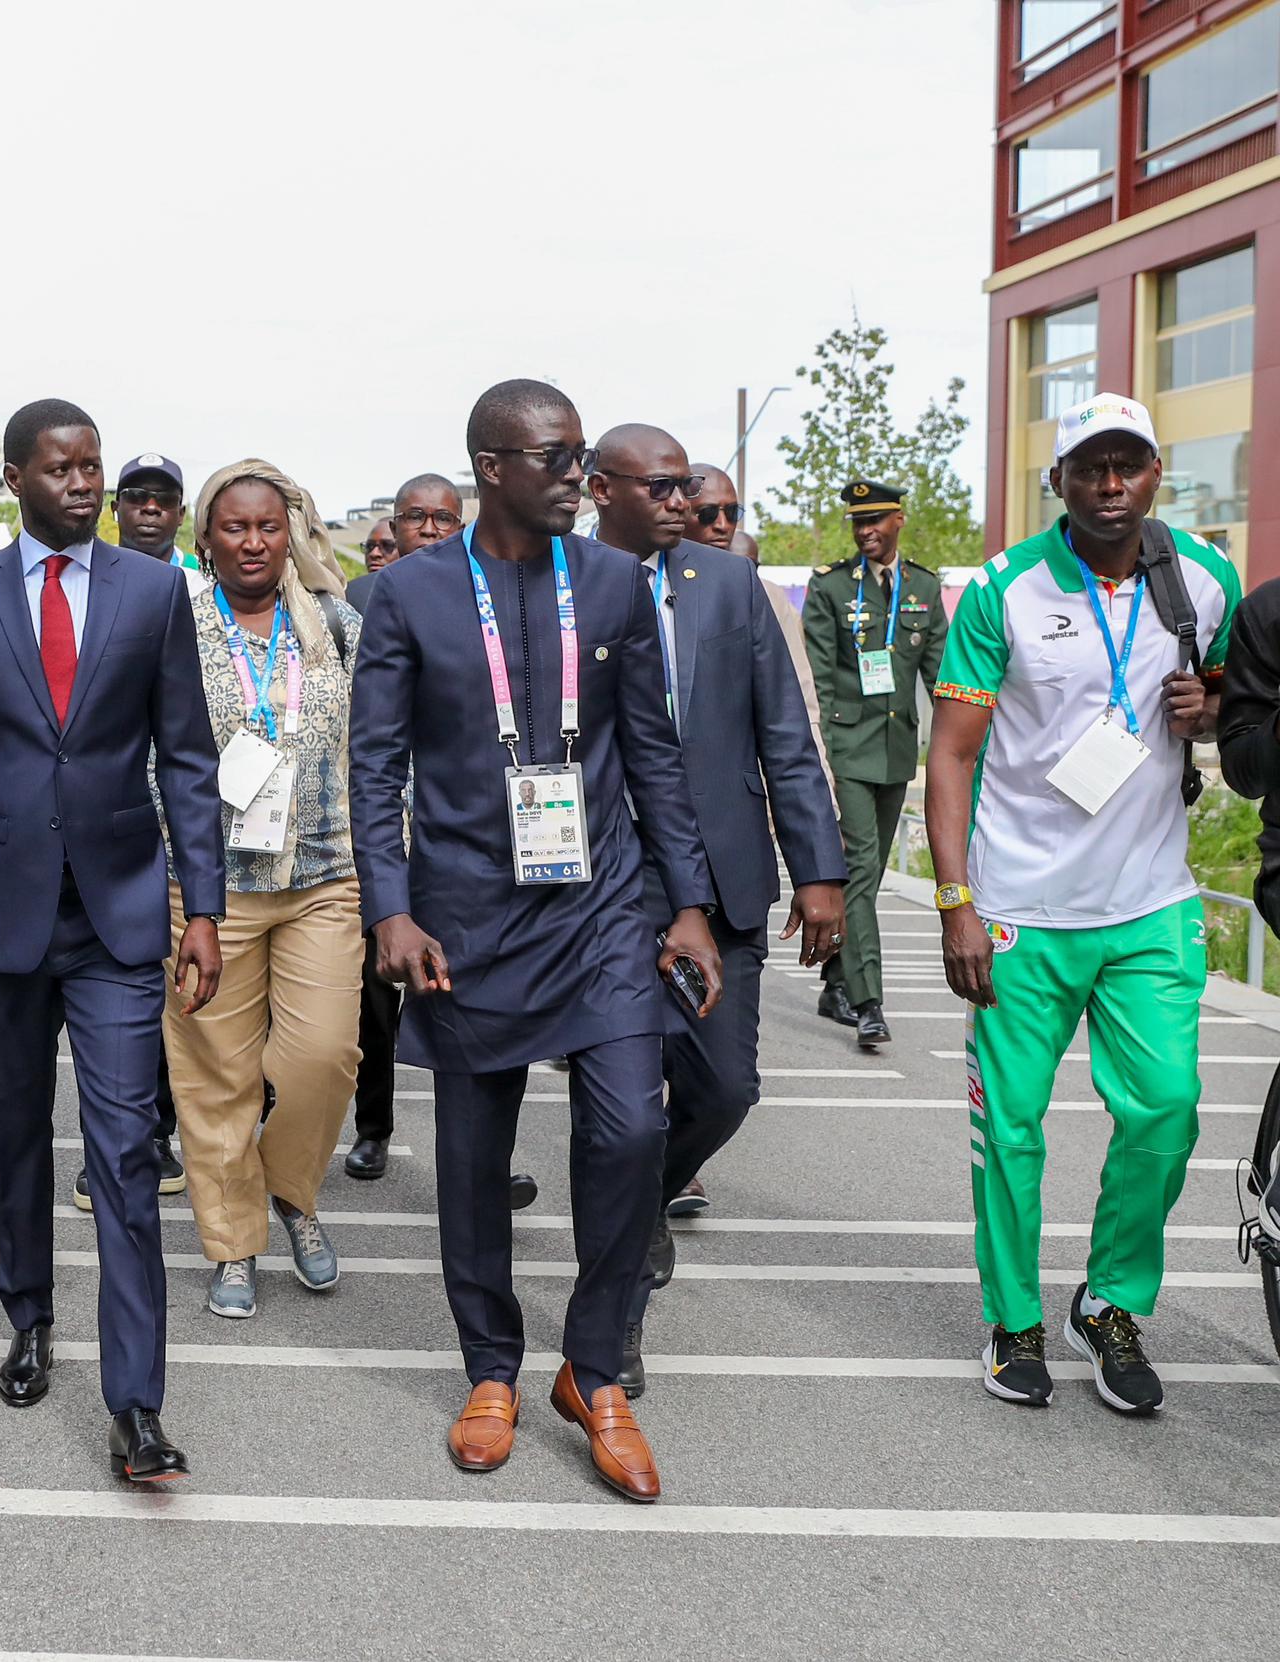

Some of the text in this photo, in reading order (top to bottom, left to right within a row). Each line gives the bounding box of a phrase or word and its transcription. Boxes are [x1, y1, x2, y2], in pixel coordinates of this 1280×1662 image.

[1080, 404, 1136, 425] SENEGAL
[265, 840, 270, 848] 6
[524, 864, 580, 878] H24 6R
